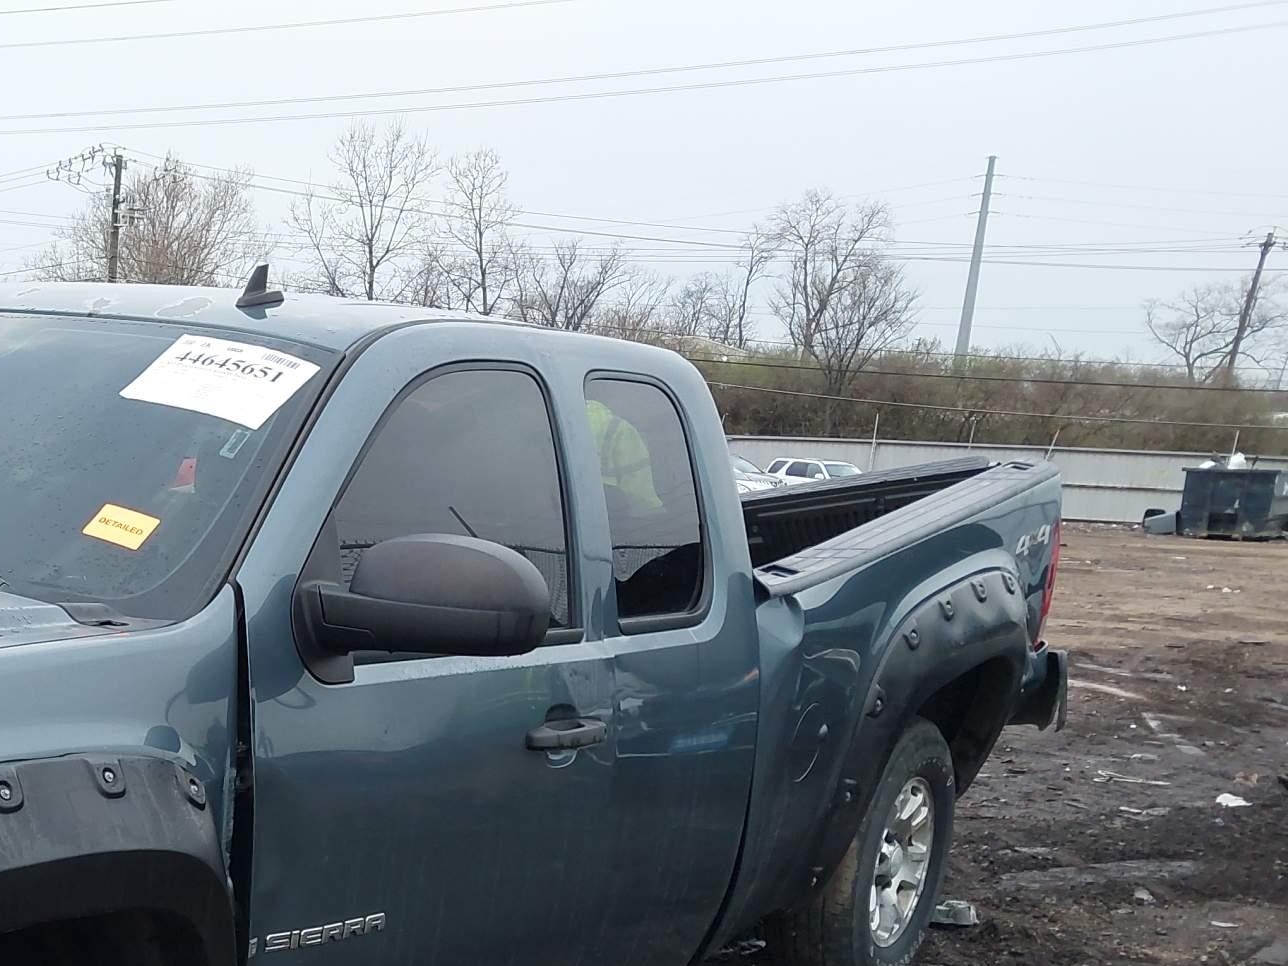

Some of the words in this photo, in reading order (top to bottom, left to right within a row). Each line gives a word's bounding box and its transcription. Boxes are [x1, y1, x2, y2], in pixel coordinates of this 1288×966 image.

[175, 350, 285, 384] 44645651
[98, 516, 144, 536] DETAILED
[265, 912, 386, 952] SIERRA
